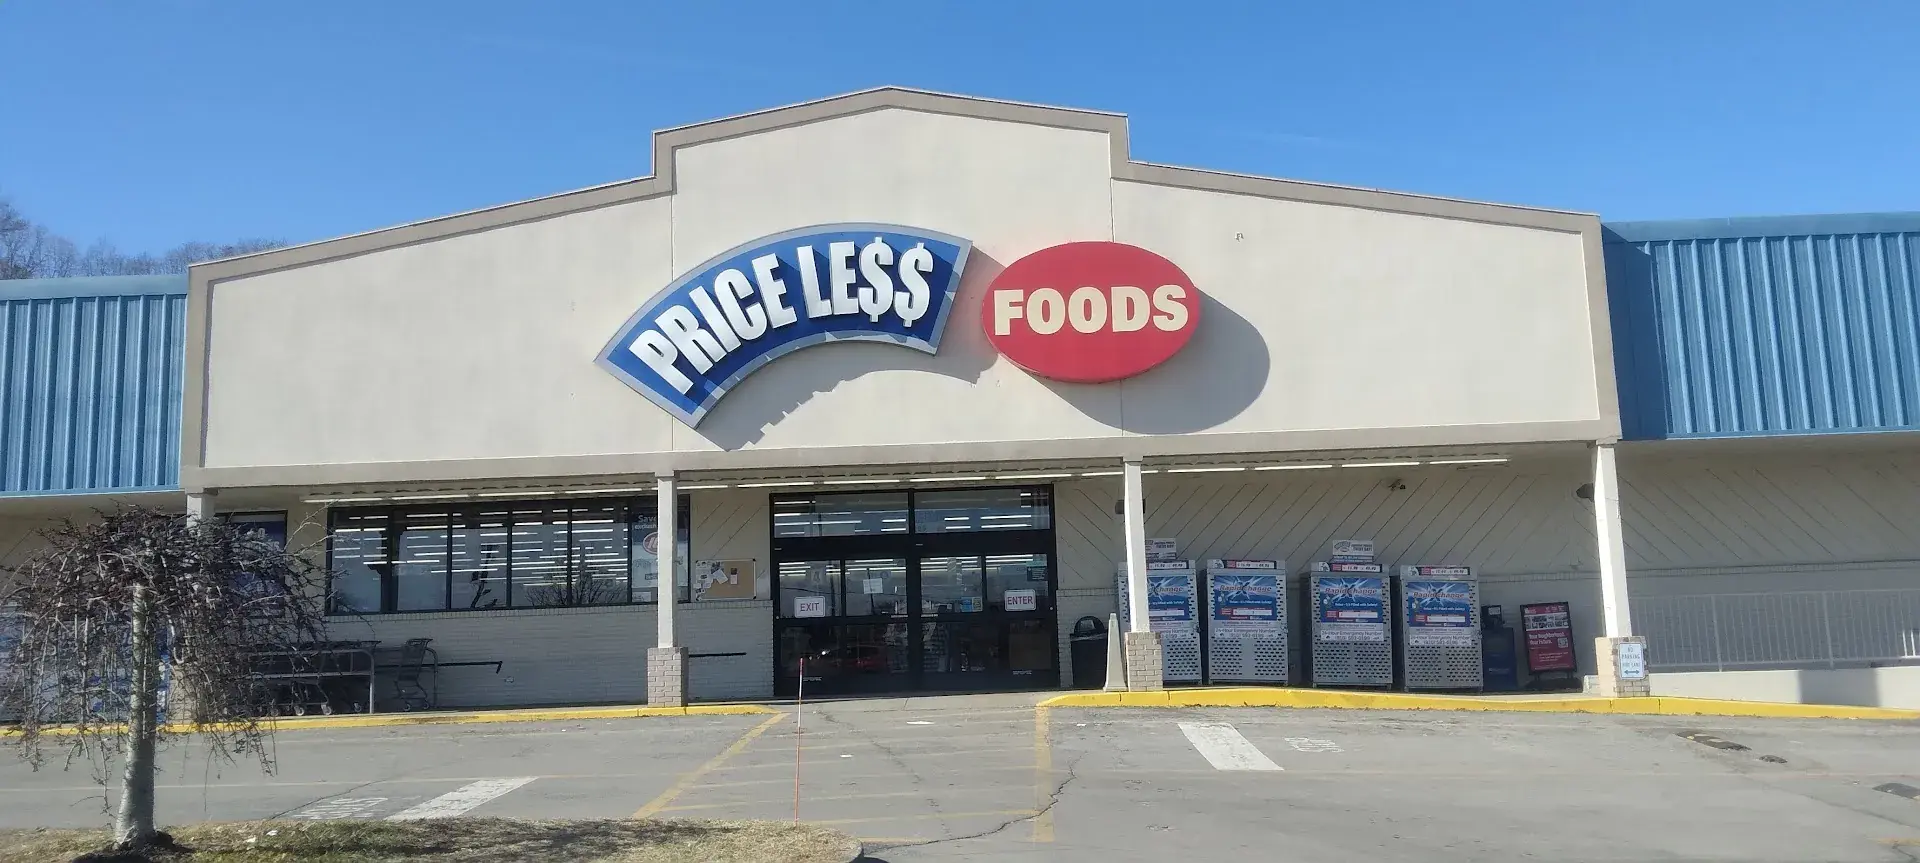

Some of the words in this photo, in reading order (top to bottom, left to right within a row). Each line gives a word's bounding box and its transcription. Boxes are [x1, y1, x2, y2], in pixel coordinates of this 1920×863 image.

[628, 253, 797, 396] PRICE
[797, 237, 934, 327] LE$$
[994, 285, 1189, 336] FOODS
[800, 602, 820, 613] EXIT
[1007, 596, 1033, 605] ENTER
